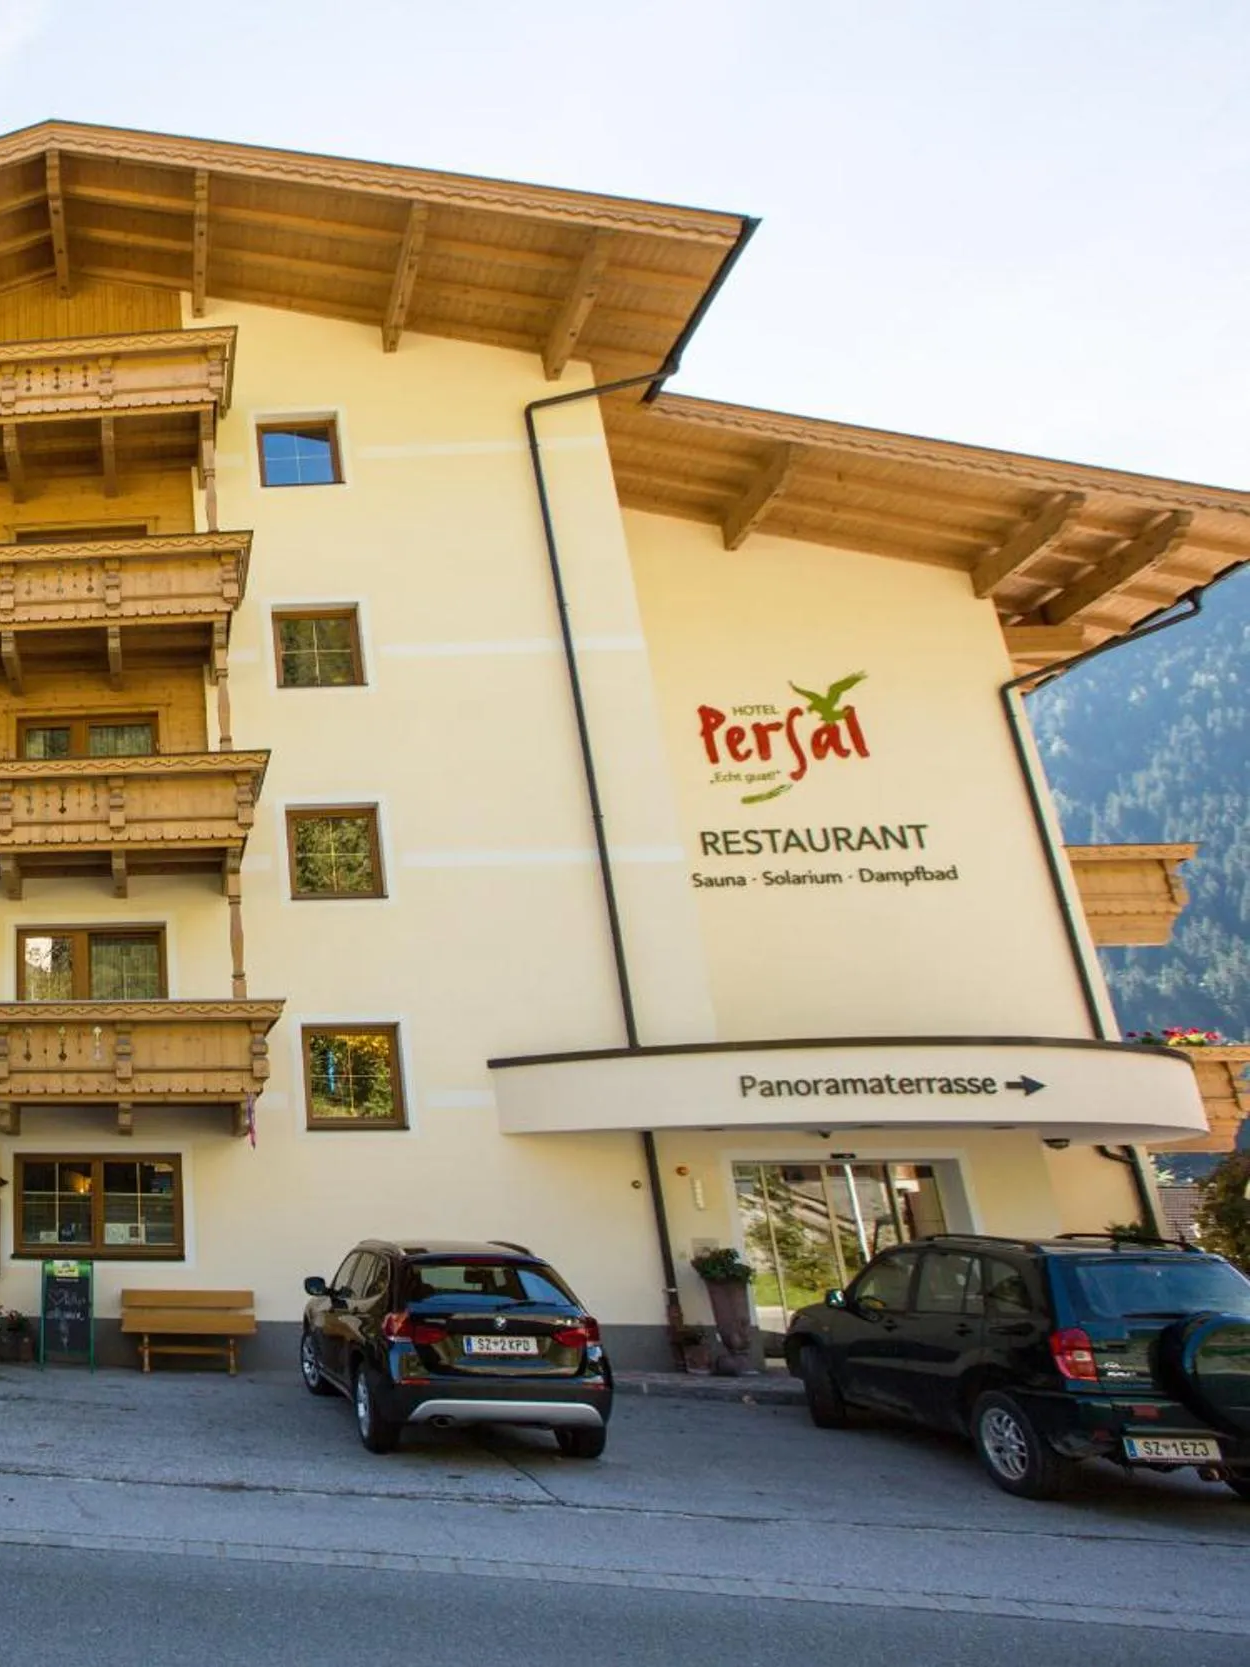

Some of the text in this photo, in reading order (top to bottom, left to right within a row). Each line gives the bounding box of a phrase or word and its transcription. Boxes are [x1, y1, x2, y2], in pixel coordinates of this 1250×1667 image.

[732, 704, 779, 717] HOTEL
[699, 824, 929, 856] RESTAURANT
[692, 865, 959, 888] Sauna Solarium Dampfbad
[739, 1073, 998, 1098] Panoramaterrasse
